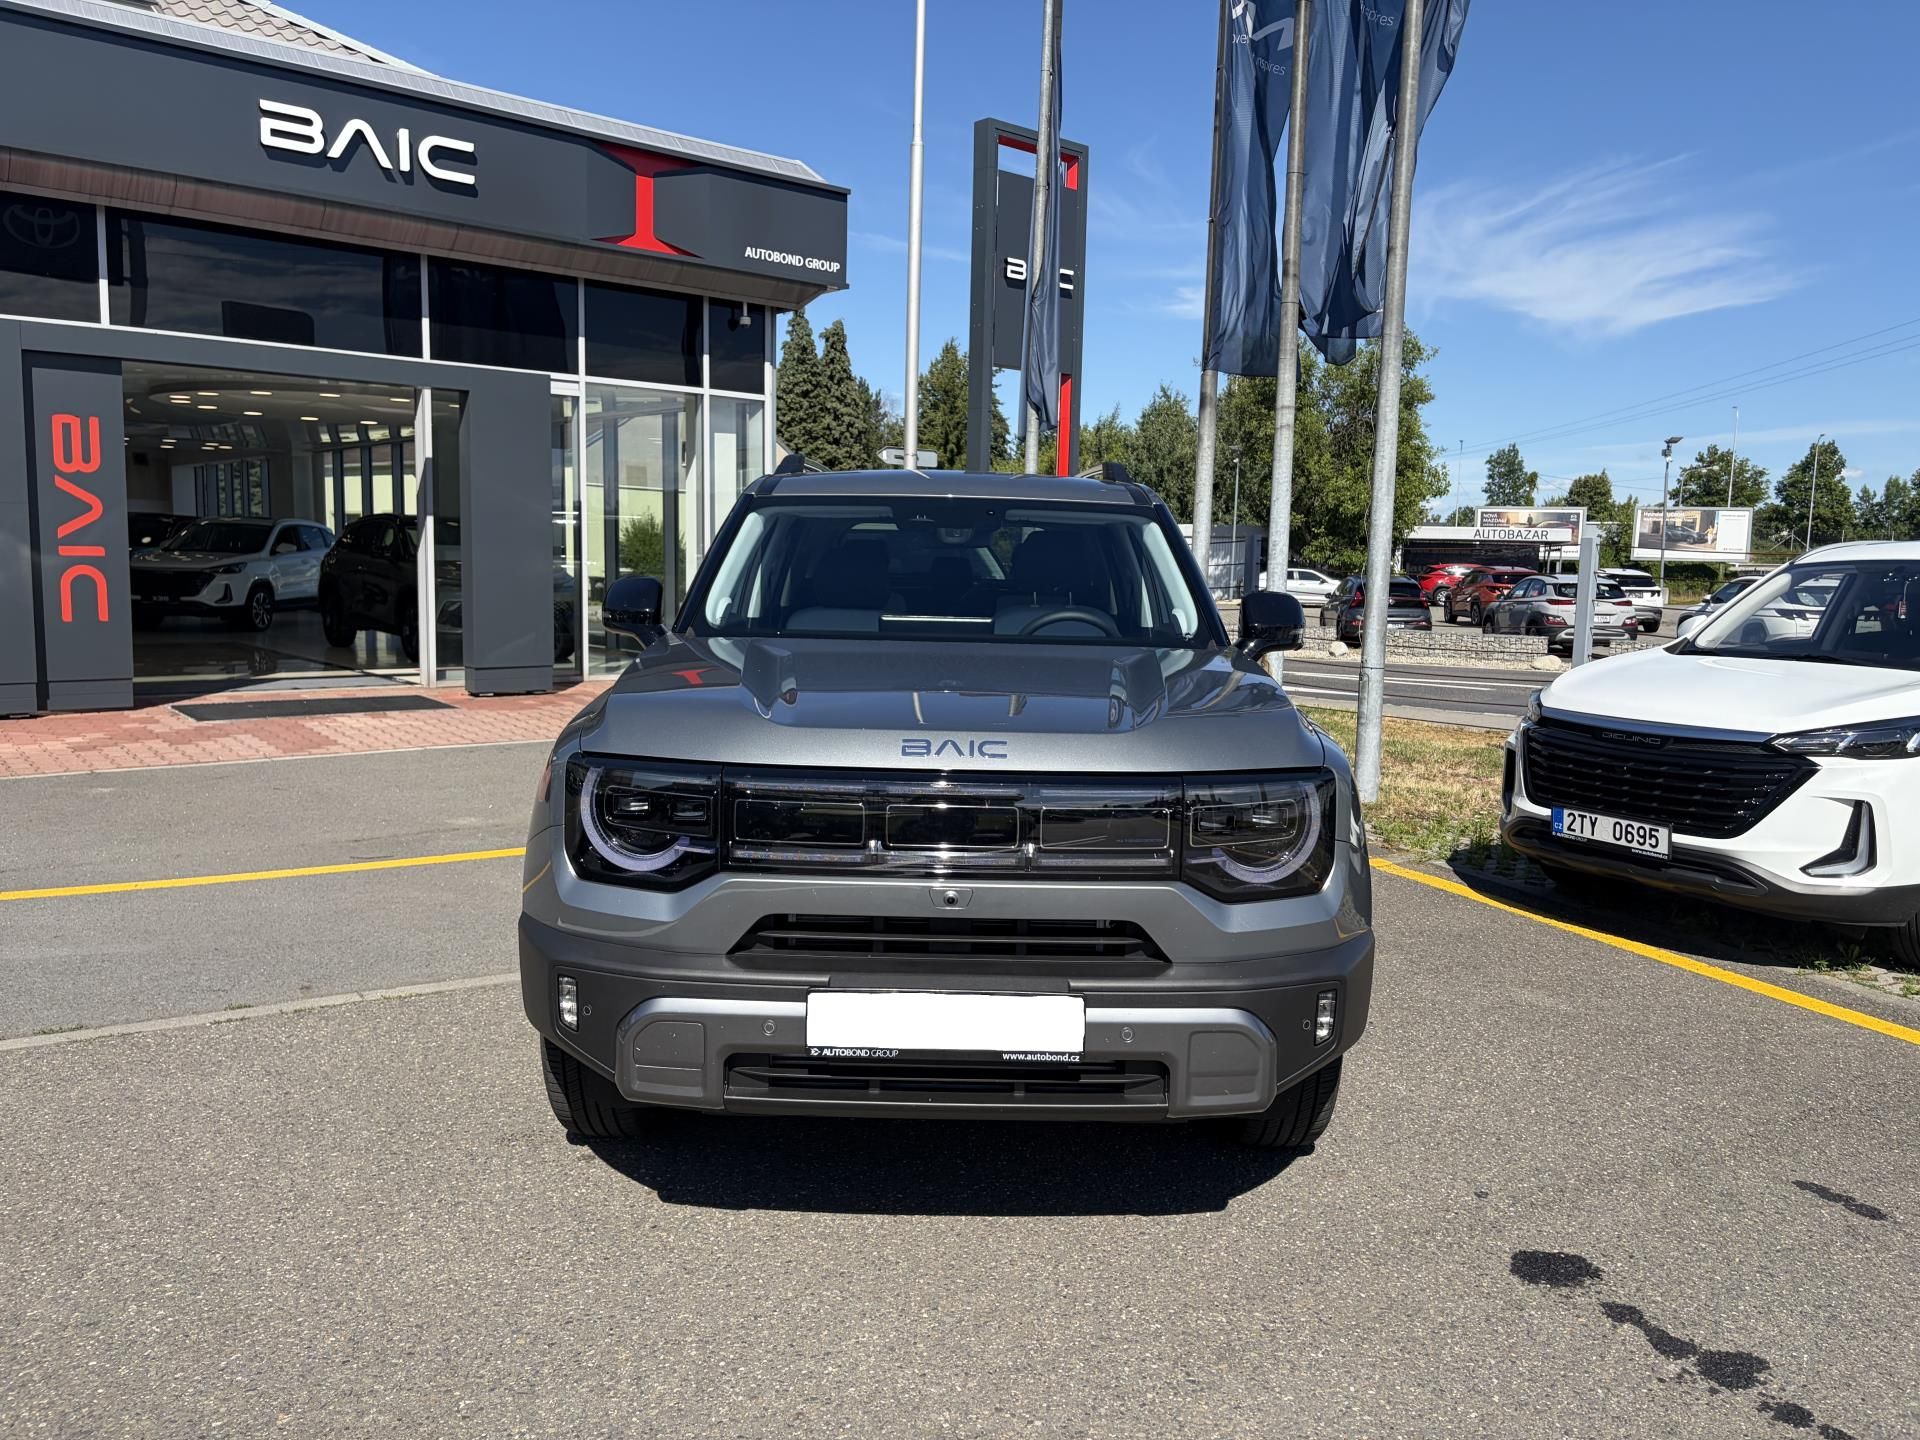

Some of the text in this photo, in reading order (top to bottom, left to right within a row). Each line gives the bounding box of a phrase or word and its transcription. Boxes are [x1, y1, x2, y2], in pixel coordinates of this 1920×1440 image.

[259, 98, 476, 186] BAIC
[744, 246, 841, 273] AUTOBOND GROUP
[1006, 256, 1075, 290] BC
[52, 413, 109, 623] BAIC
[1473, 528, 1549, 540] AUTOBAZAR
[901, 738, 1008, 759] BAIC
[1554, 822, 1563, 830] CZ
[1566, 812, 1660, 849] 2TY 0695
[822, 1048, 899, 1058] AUTOBOND GROUP
[1002, 1052, 1080, 1062] www.autobond.cz
